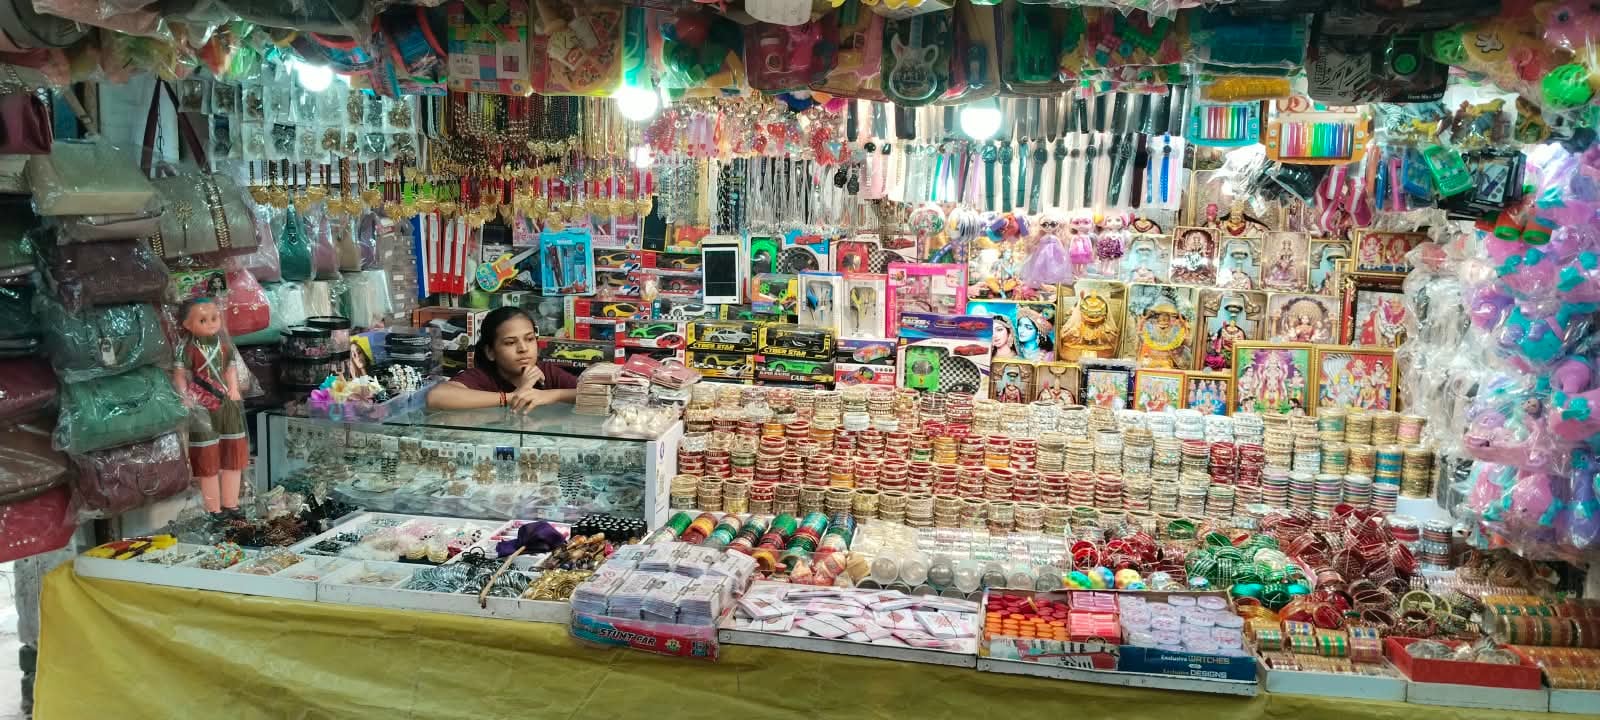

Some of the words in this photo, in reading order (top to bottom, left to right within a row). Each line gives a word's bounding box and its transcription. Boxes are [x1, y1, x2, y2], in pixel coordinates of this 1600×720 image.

[788, 349, 807, 358] STAR
[599, 628, 636, 641] STUNT
[636, 634, 657, 647] CAR
[1188, 655, 1230, 664] WATCHES
[1190, 669, 1227, 678] DESIGNS
